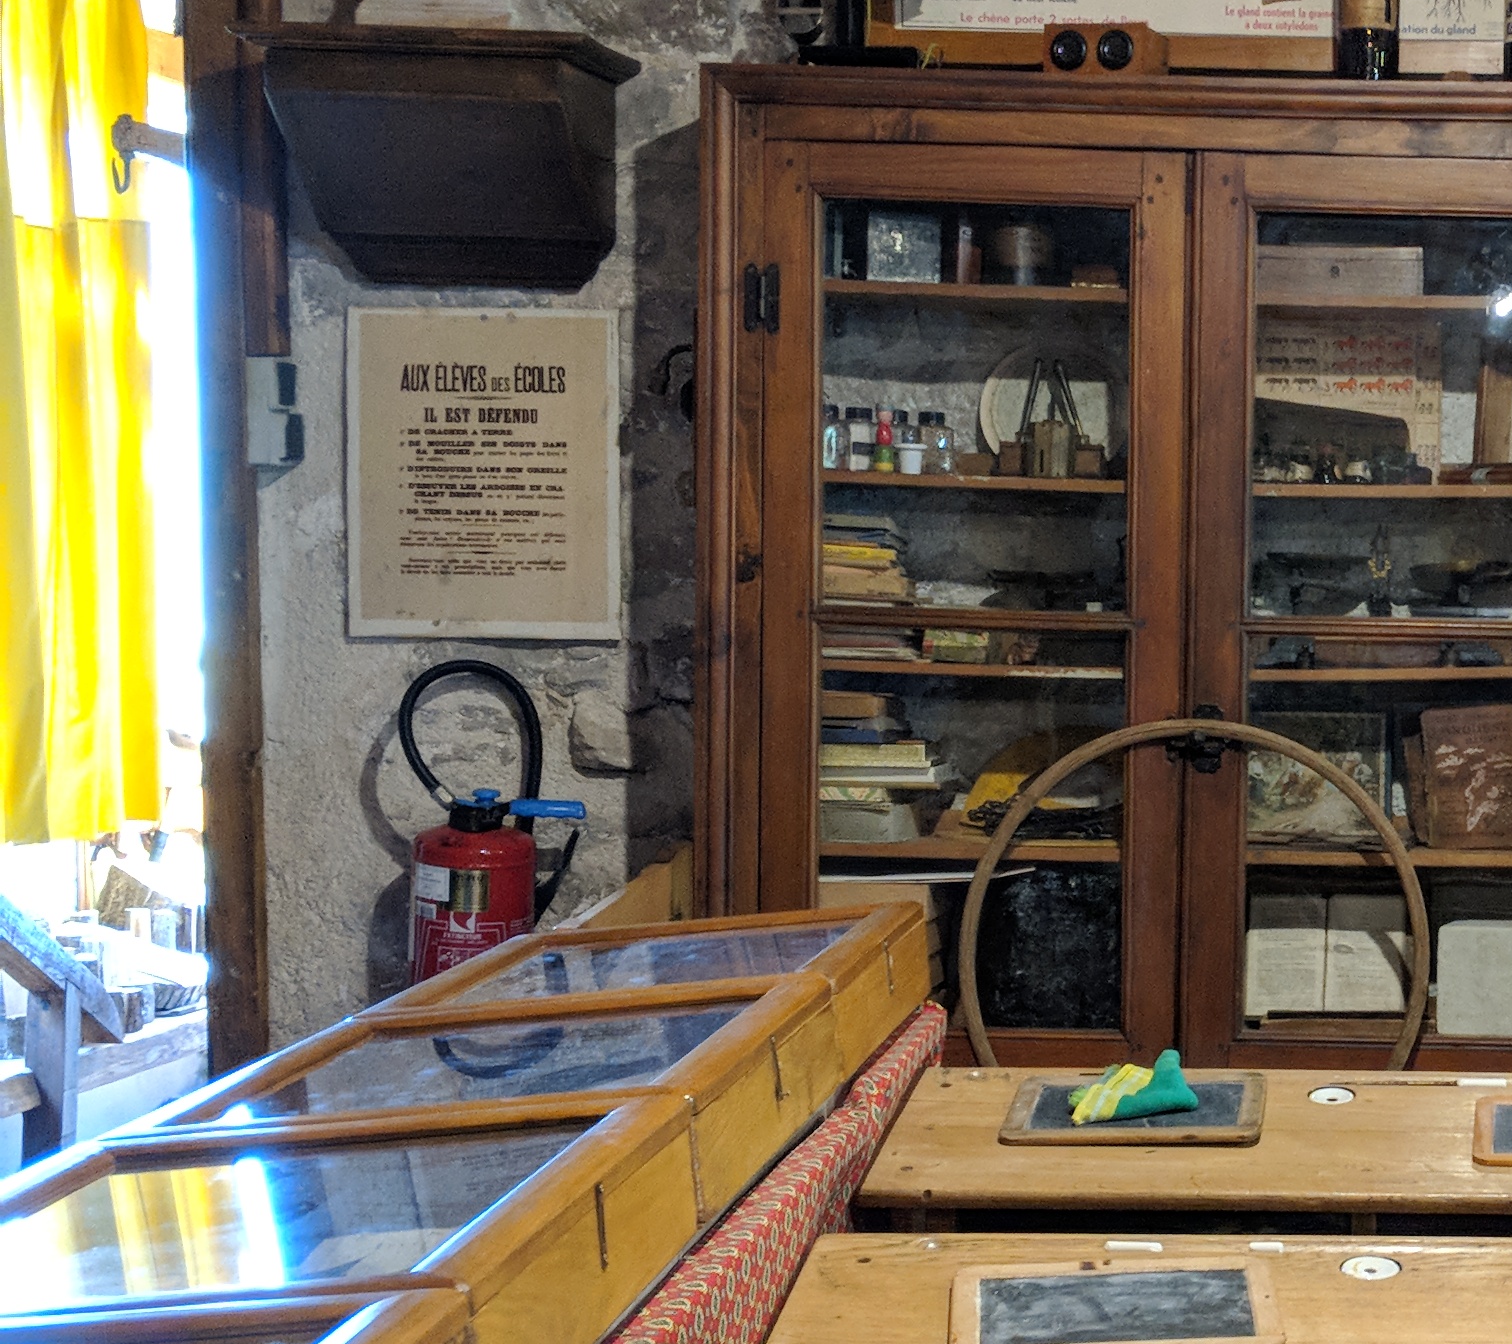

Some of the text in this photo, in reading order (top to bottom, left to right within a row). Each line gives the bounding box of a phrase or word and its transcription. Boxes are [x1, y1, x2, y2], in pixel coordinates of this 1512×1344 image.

[1225, 7, 1307, 18] Le gland la
[960, 13, 1044, 25] Le chêne porte
[1253, 21, 1274, 30] deux
[1431, 24, 1444, 35] du
[1446, 24, 1476, 35] gland
[401, 361, 566, 394] AUX ÉLÈVES DES ÉCOLES
[424, 407, 437, 423] IL
[445, 408, 471, 423] EST
